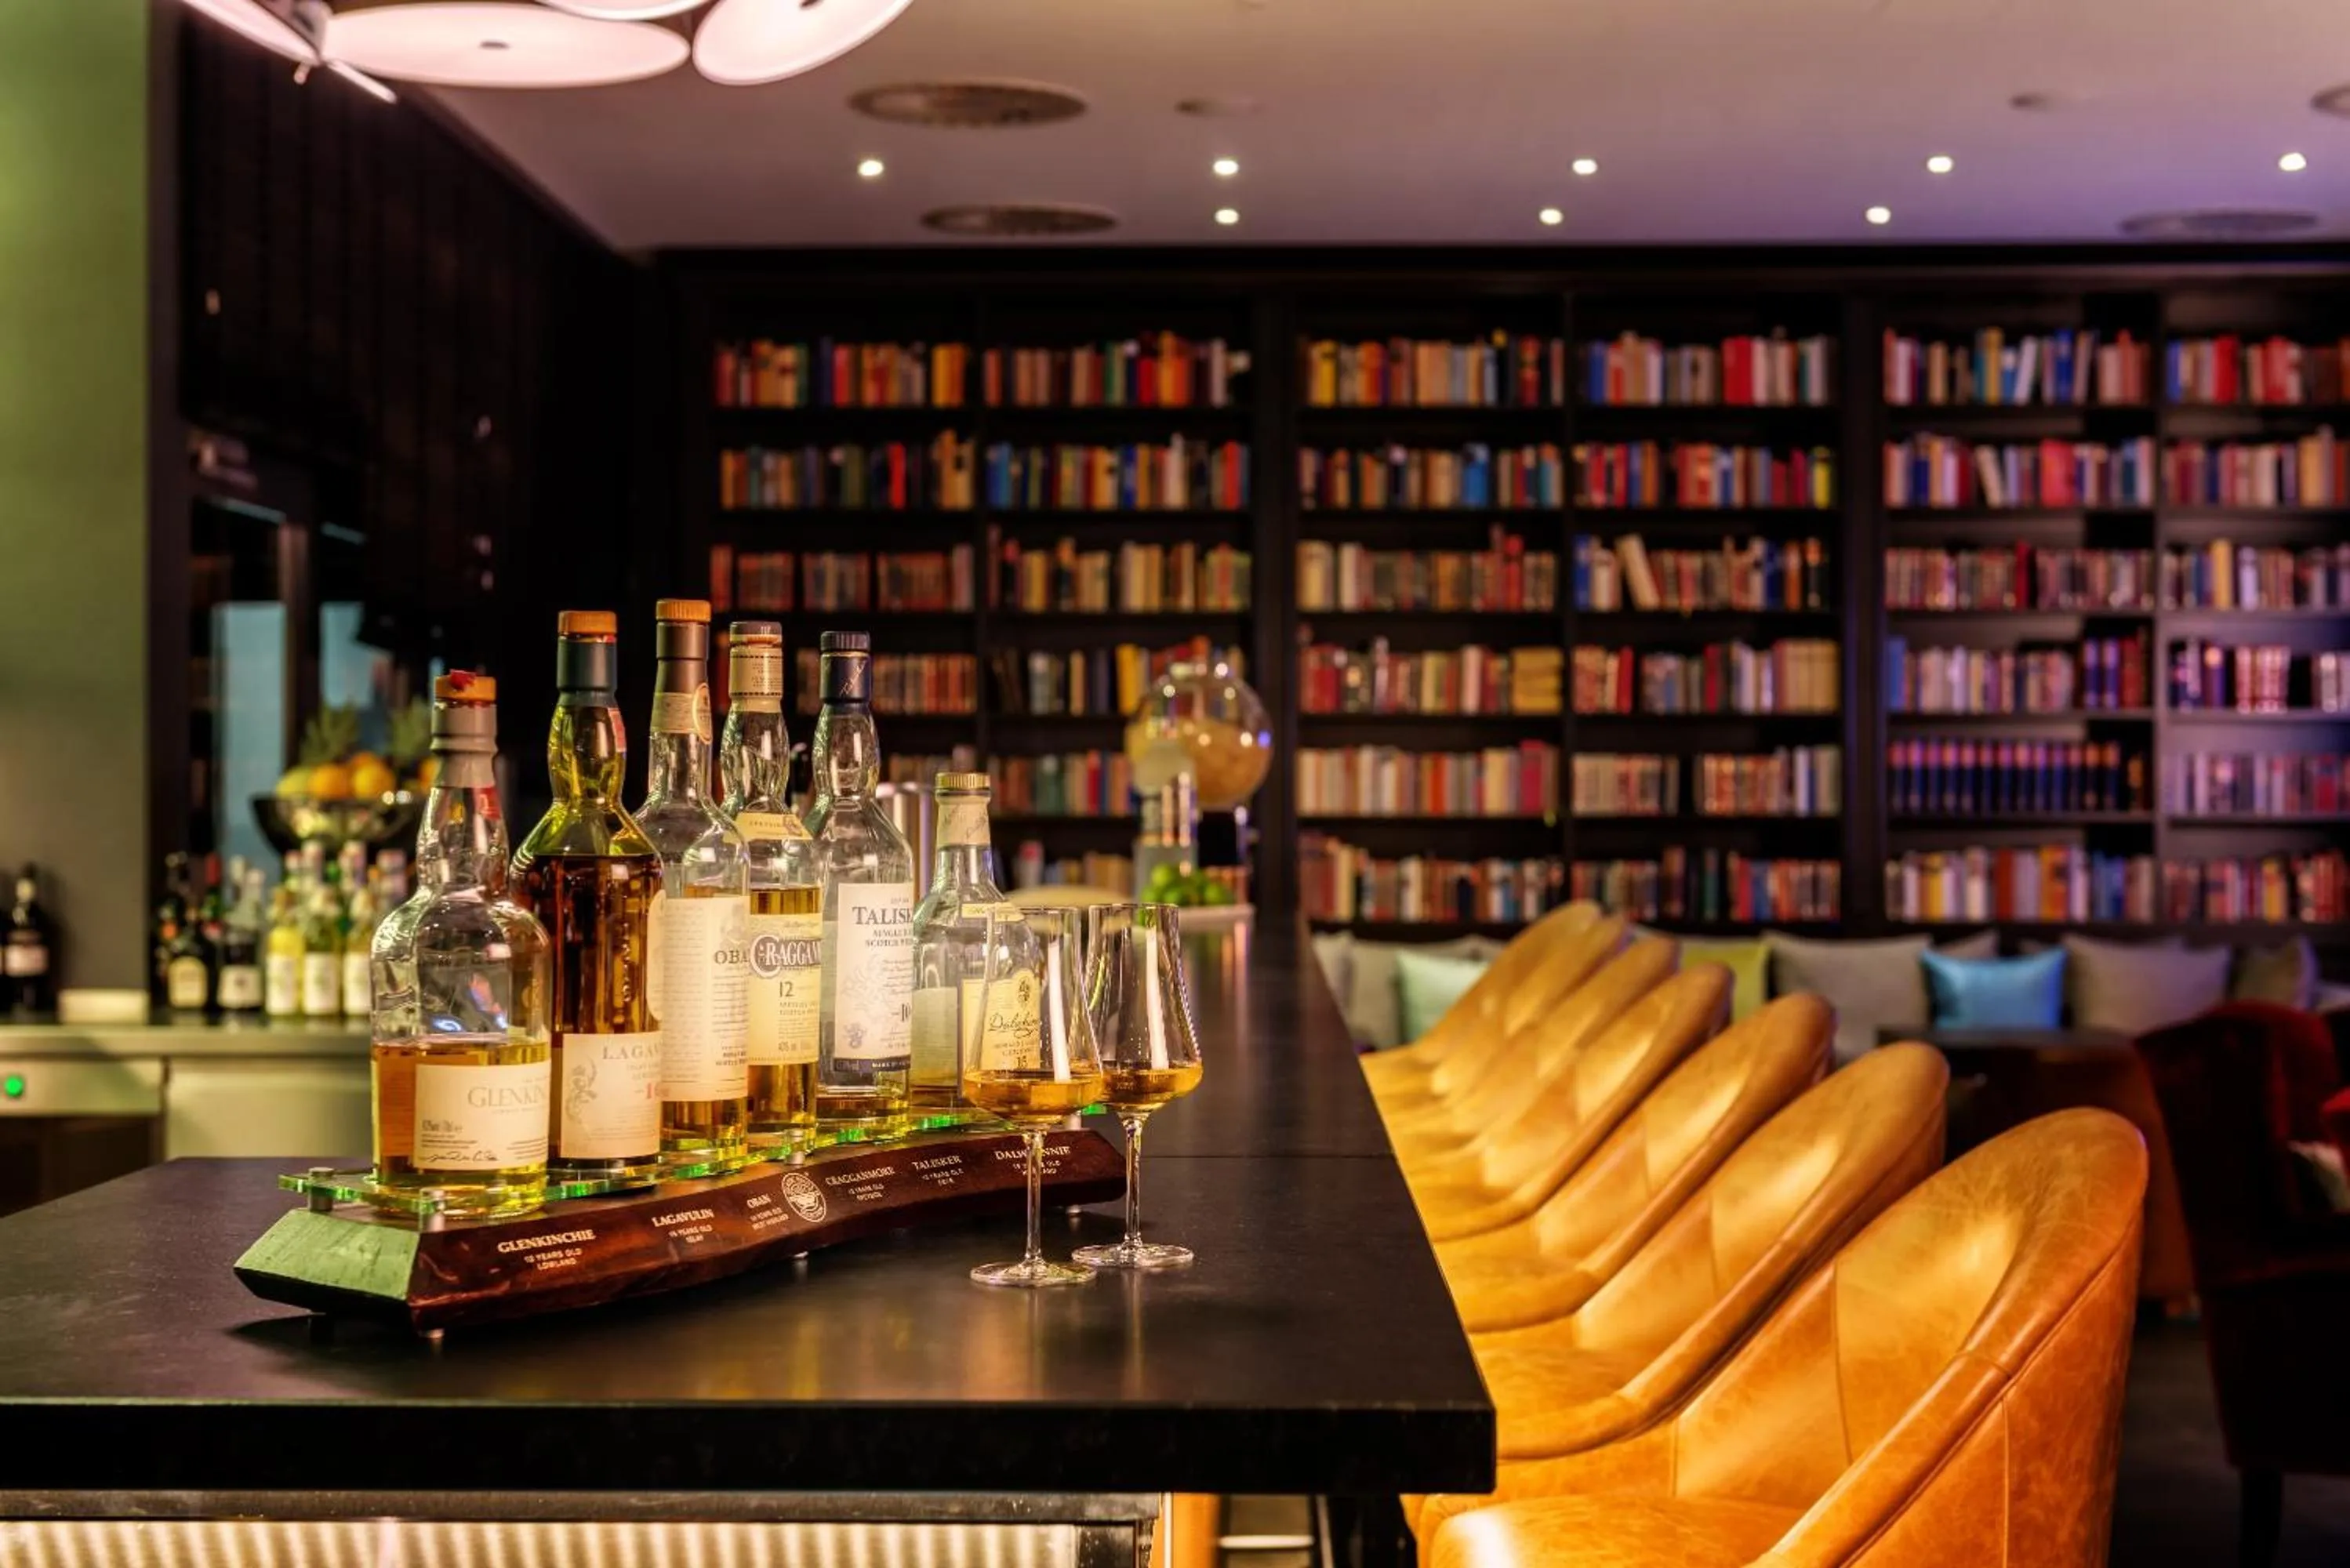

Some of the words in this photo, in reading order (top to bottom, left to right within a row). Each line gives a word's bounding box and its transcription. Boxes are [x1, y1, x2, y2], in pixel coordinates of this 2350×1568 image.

[779, 981, 795, 997] 12
[994, 1146, 1071, 1160] DALWNNIE
[911, 1156, 962, 1171] TALISKER
[825, 1167, 895, 1185] CRAGGANMORE
[746, 1193, 772, 1208] OBAN
[651, 1208, 714, 1227] LAGAVULIN
[497, 1229, 596, 1253] GLENKINCHIE
